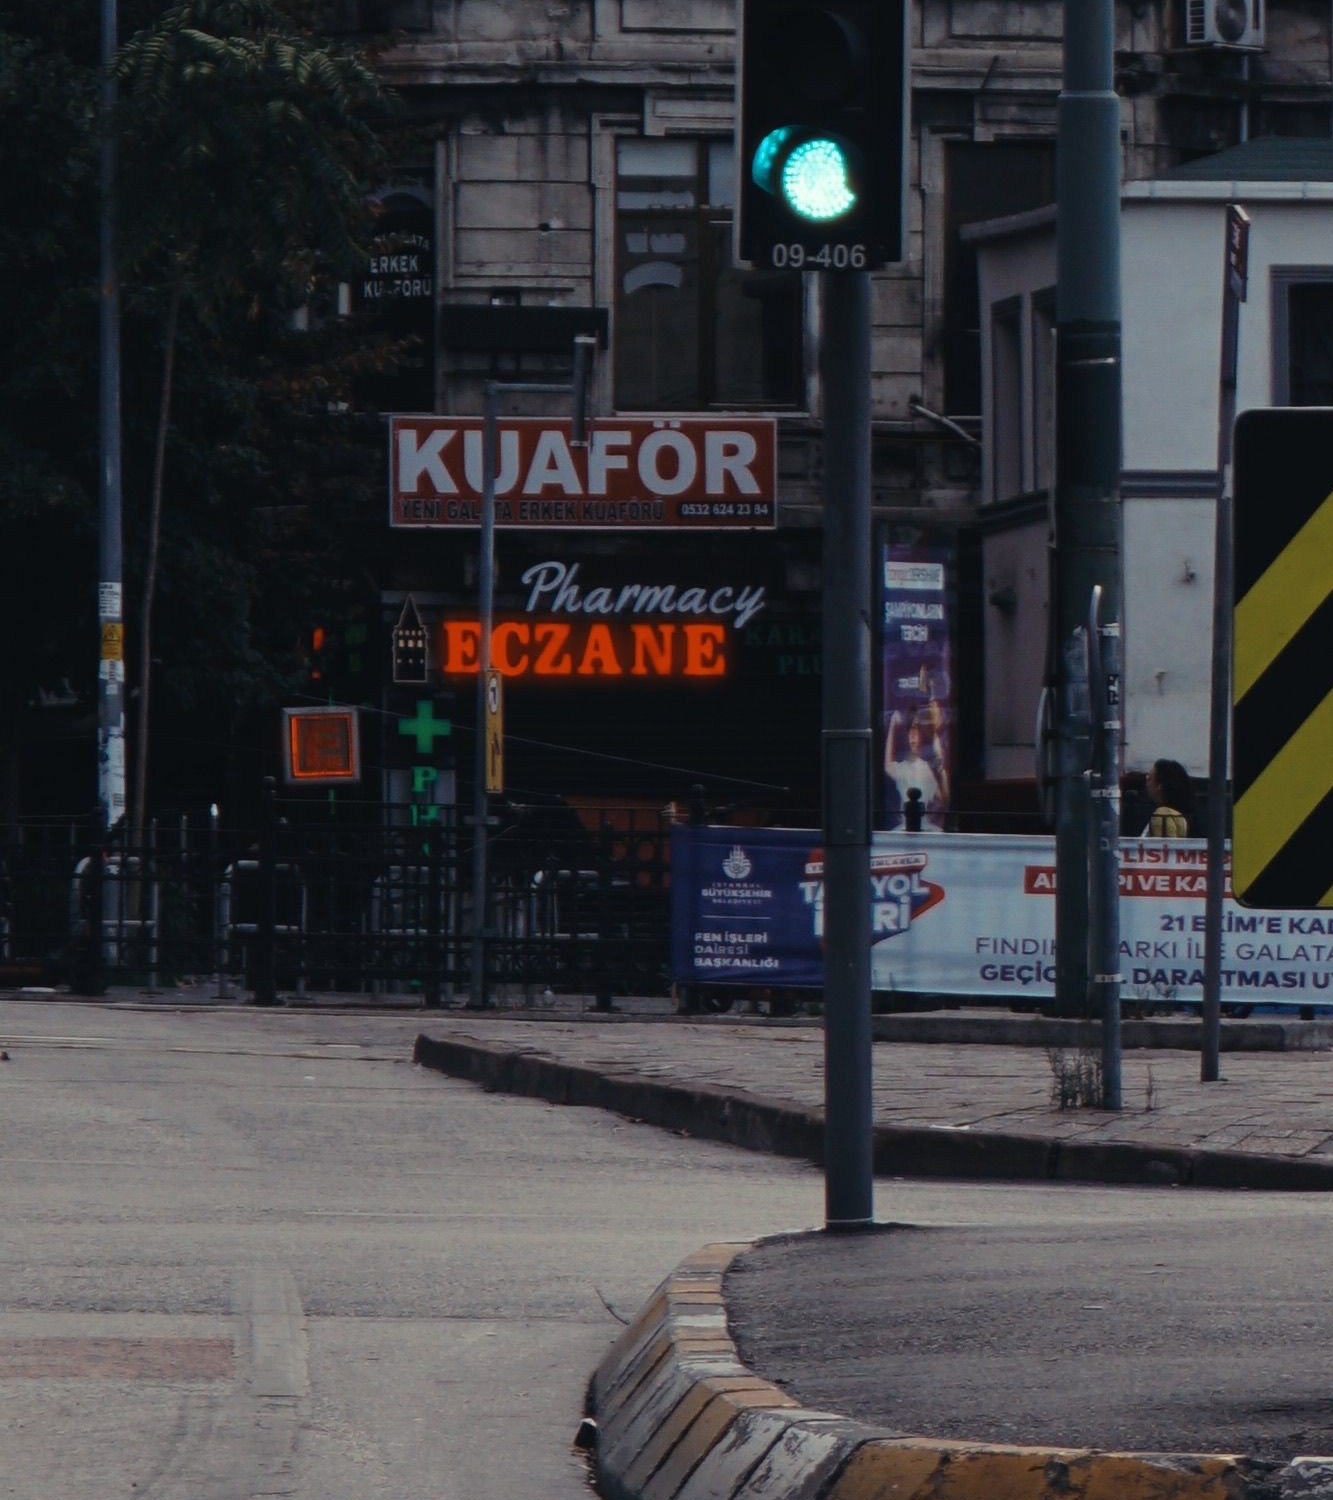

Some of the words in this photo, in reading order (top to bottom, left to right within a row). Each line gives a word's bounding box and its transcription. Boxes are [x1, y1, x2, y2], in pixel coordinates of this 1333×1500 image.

[370, 254, 419, 273] ERKEK
[772, 243, 867, 268] 09-406
[400, 420, 761, 496] KUAFÖR
[402, 498, 441, 521] YENİ
[447, 501, 512, 521] GALTA
[519, 501, 576, 521] ERKEK
[582, 497, 664, 522] KUAFÖRÜ
[522, 561, 766, 629] Pharmacy
[443, 621, 727, 677] ECZANE
[1118, 843, 1168, 864] LİSİ
[870, 871, 930, 898] YOL
[1139, 876, 1170, 892] VE
[1160, 915, 1185, 932] 21
[1191, 911, 1281, 934] EİM'E
[694, 932, 722, 944] FEN
[1119, 941, 1177, 959] ARKI
[1133, 967, 1305, 989] DARATMASI
